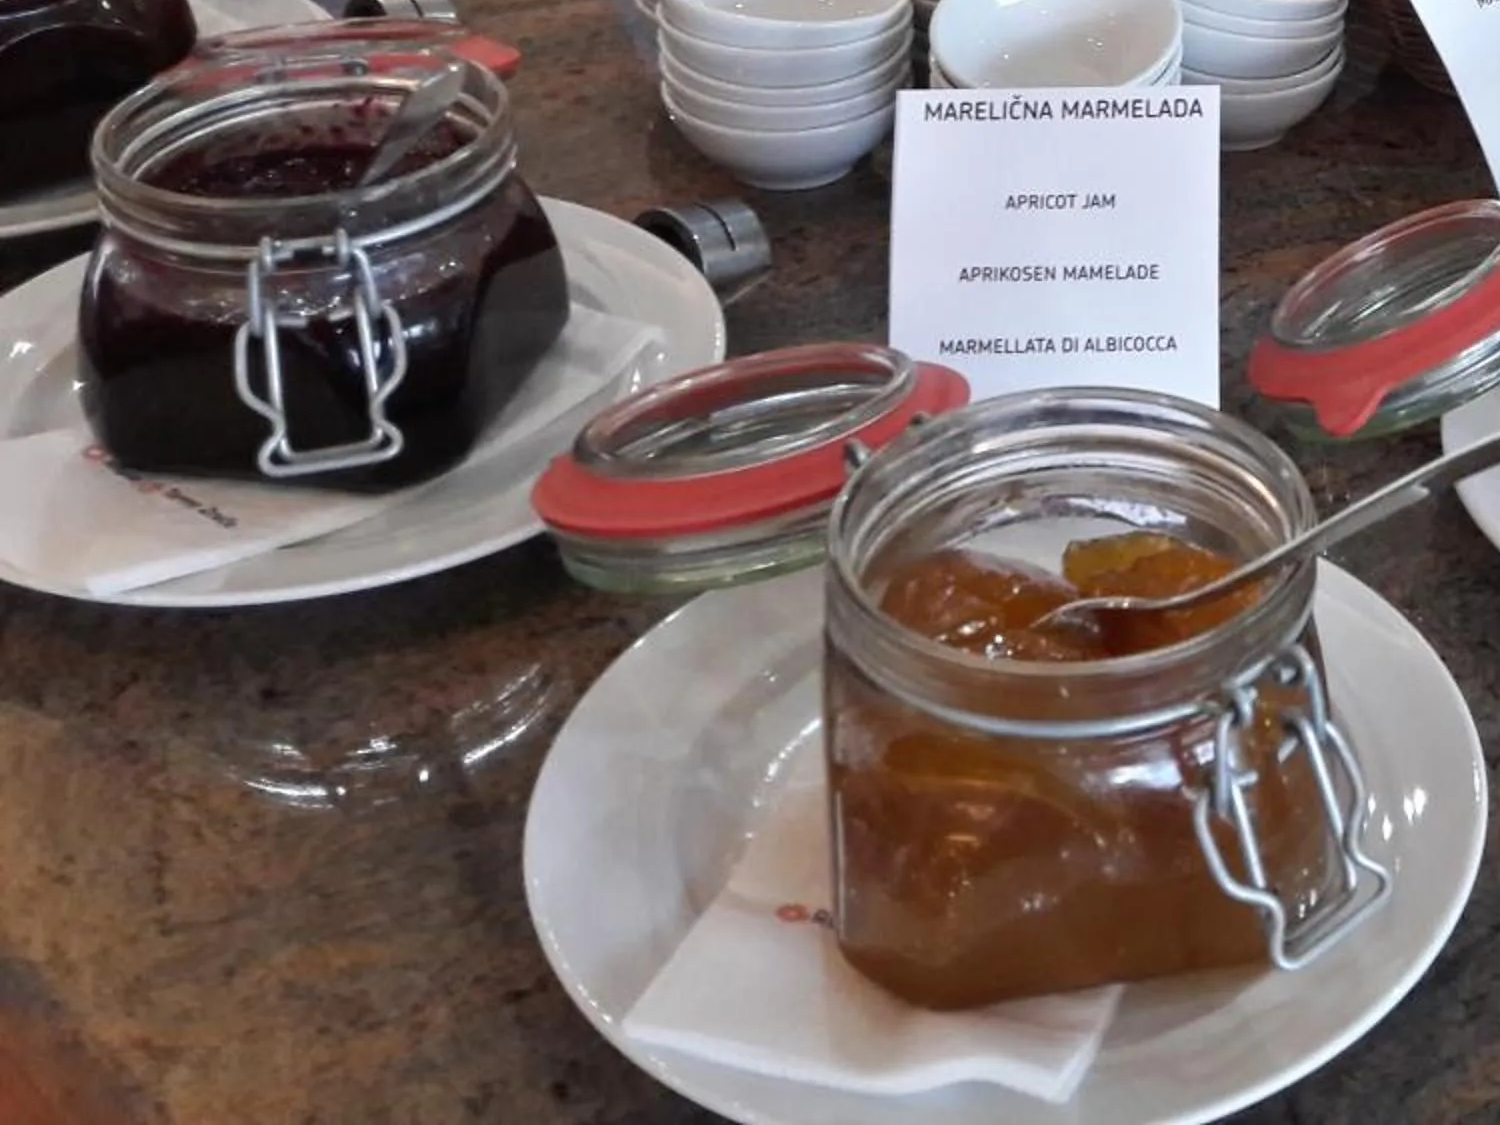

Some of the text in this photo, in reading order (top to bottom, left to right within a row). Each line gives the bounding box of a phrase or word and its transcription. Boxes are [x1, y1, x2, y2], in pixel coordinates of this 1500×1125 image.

[924, 94, 1204, 122] MARELIČNA MARMELADA
[1005, 193, 1116, 210] APRICOT JAM
[958, 264, 1160, 283] APRIKOSEN MAMELADE
[939, 335, 1178, 355] MARMELLATA DI ALBICOCCA
